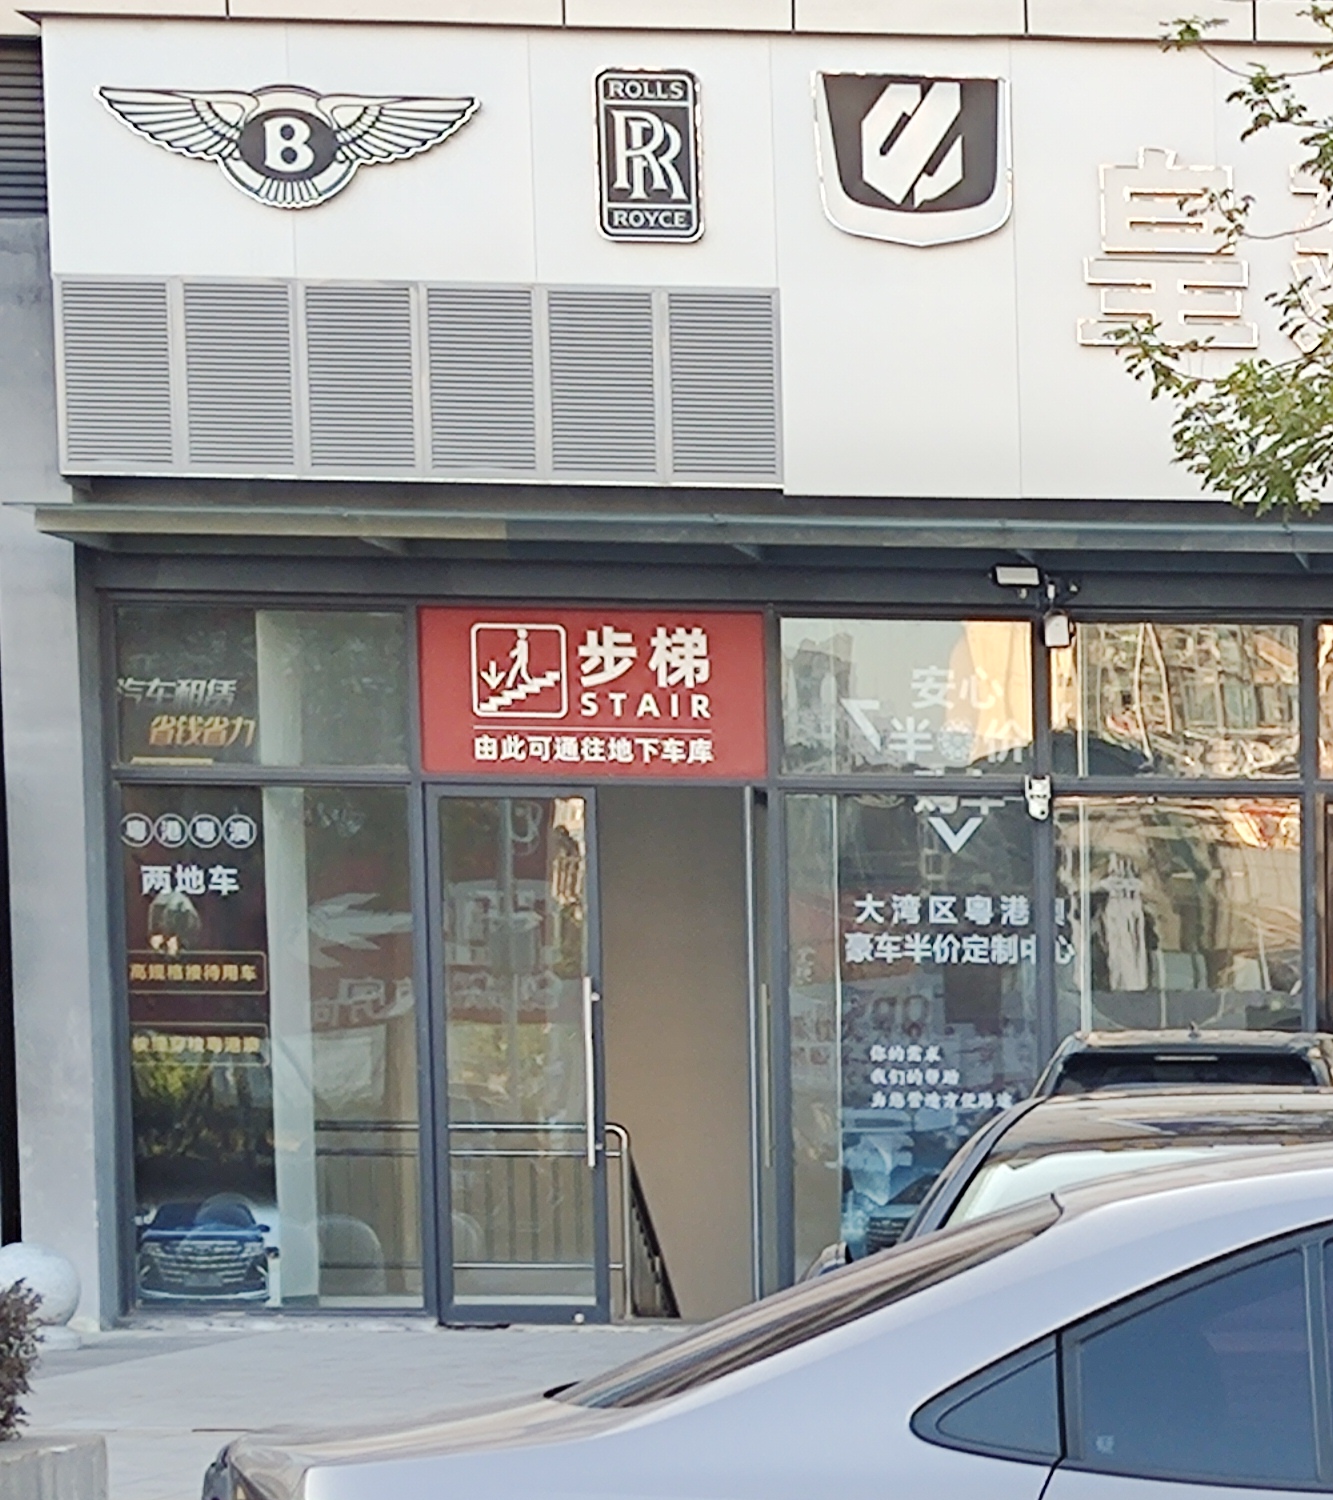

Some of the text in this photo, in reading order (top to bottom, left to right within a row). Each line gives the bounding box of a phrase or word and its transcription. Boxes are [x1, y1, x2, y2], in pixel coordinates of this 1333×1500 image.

[607, 79, 684, 100] ROLLS
[263, 116, 316, 173] B
[612, 209, 687, 229] ROYCE
[578, 625, 711, 688] 步梯
[117, 677, 237, 706] 汽车租赁
[910, 664, 1004, 710] 安心
[580, 692, 712, 719] STAIR
[150, 714, 256, 748] 省钱省力
[473, 735, 714, 764] 由此可通往地下车库
[140, 863, 240, 896] 两地车
[844, 931, 1077, 965] 豪车半价定制中心
